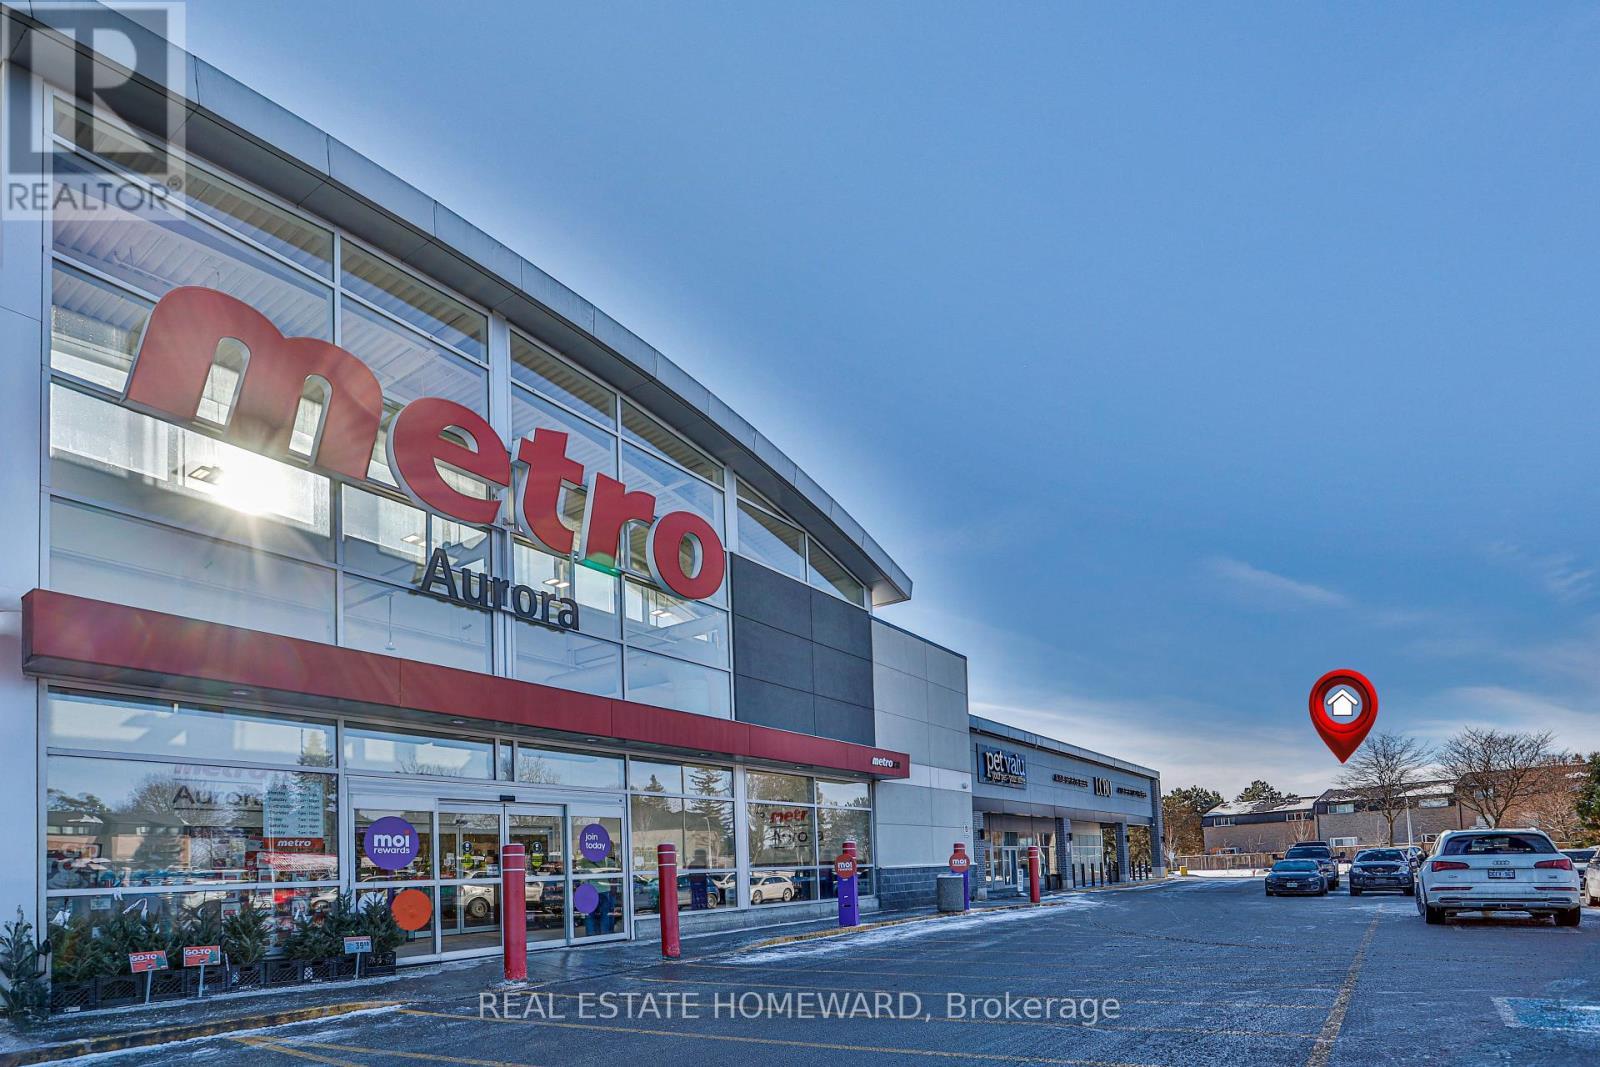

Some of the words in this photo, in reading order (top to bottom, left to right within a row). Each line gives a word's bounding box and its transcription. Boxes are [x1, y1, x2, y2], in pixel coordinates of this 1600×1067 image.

[122, 285, 726, 600] metro
[421, 547, 581, 633] Aurora
[985, 750, 1004, 777] pet
[1004, 753, 1026, 776] valu
[277, 839, 312, 848] metro
[373, 828, 411, 848] moi
[585, 832, 599, 842] join
[373, 847, 411, 855] rewards
[585, 842, 606, 851] today
